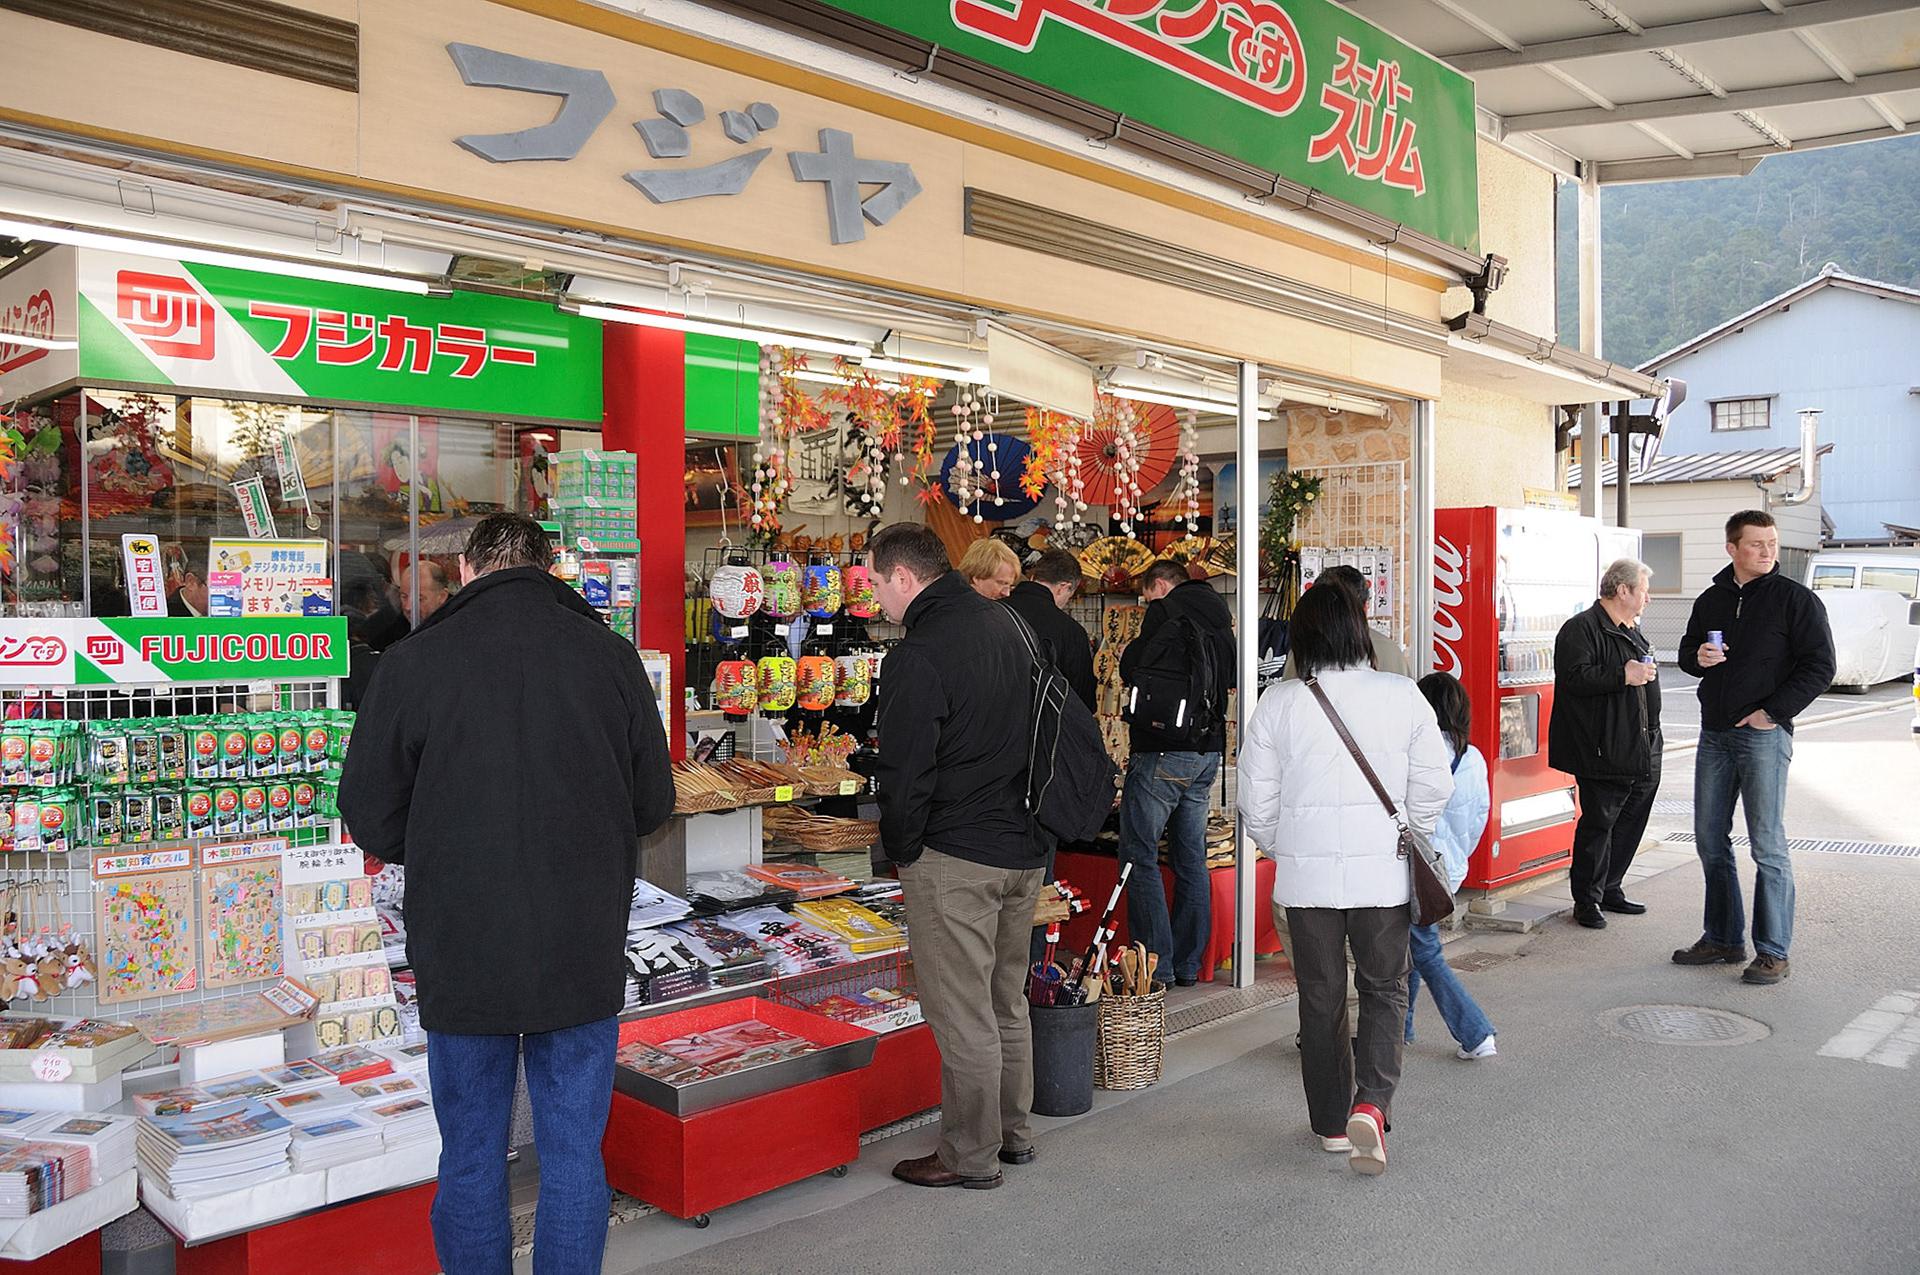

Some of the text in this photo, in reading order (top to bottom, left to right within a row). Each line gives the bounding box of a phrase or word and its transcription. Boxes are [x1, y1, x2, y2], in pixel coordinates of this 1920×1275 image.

[1332, 36, 1413, 109] スーパー
[446, 42, 922, 245] フジヤ
[1307, 82, 1426, 198] スリム
[248, 300, 537, 379] フジカラー
[254, 562, 322, 574] デジタルカメラ用
[271, 550, 306, 562] 携帯電話
[135, 558, 158, 611] 宅急便
[141, 633, 333, 663] FUJICOLOR
[102, 852, 184, 870] 木製知育パズル
[208, 842, 282, 859] 木製知育パズル
